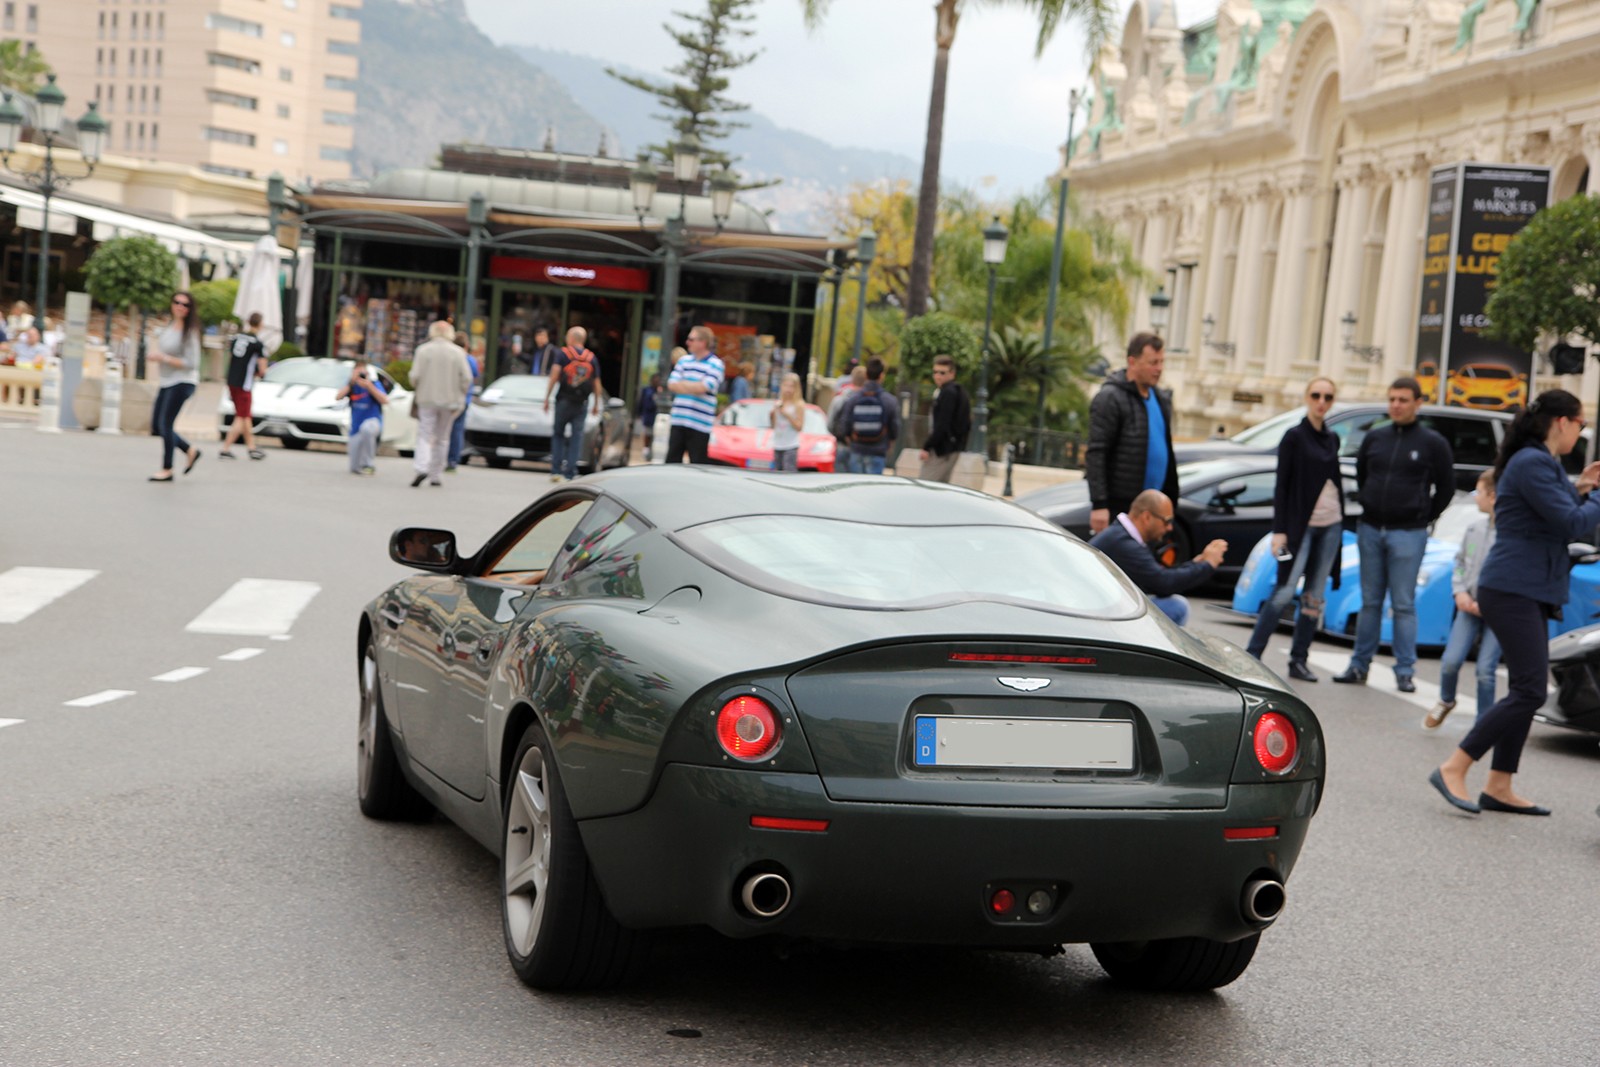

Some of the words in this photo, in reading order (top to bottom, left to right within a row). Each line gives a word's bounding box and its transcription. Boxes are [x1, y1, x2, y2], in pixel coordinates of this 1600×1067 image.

[1492, 187, 1520, 199] TOP
[1473, 199, 1537, 215] MARQUES
[1456, 255, 1500, 275] LUC
[1459, 313, 1473, 327] LE
[922, 746, 930, 757] D
